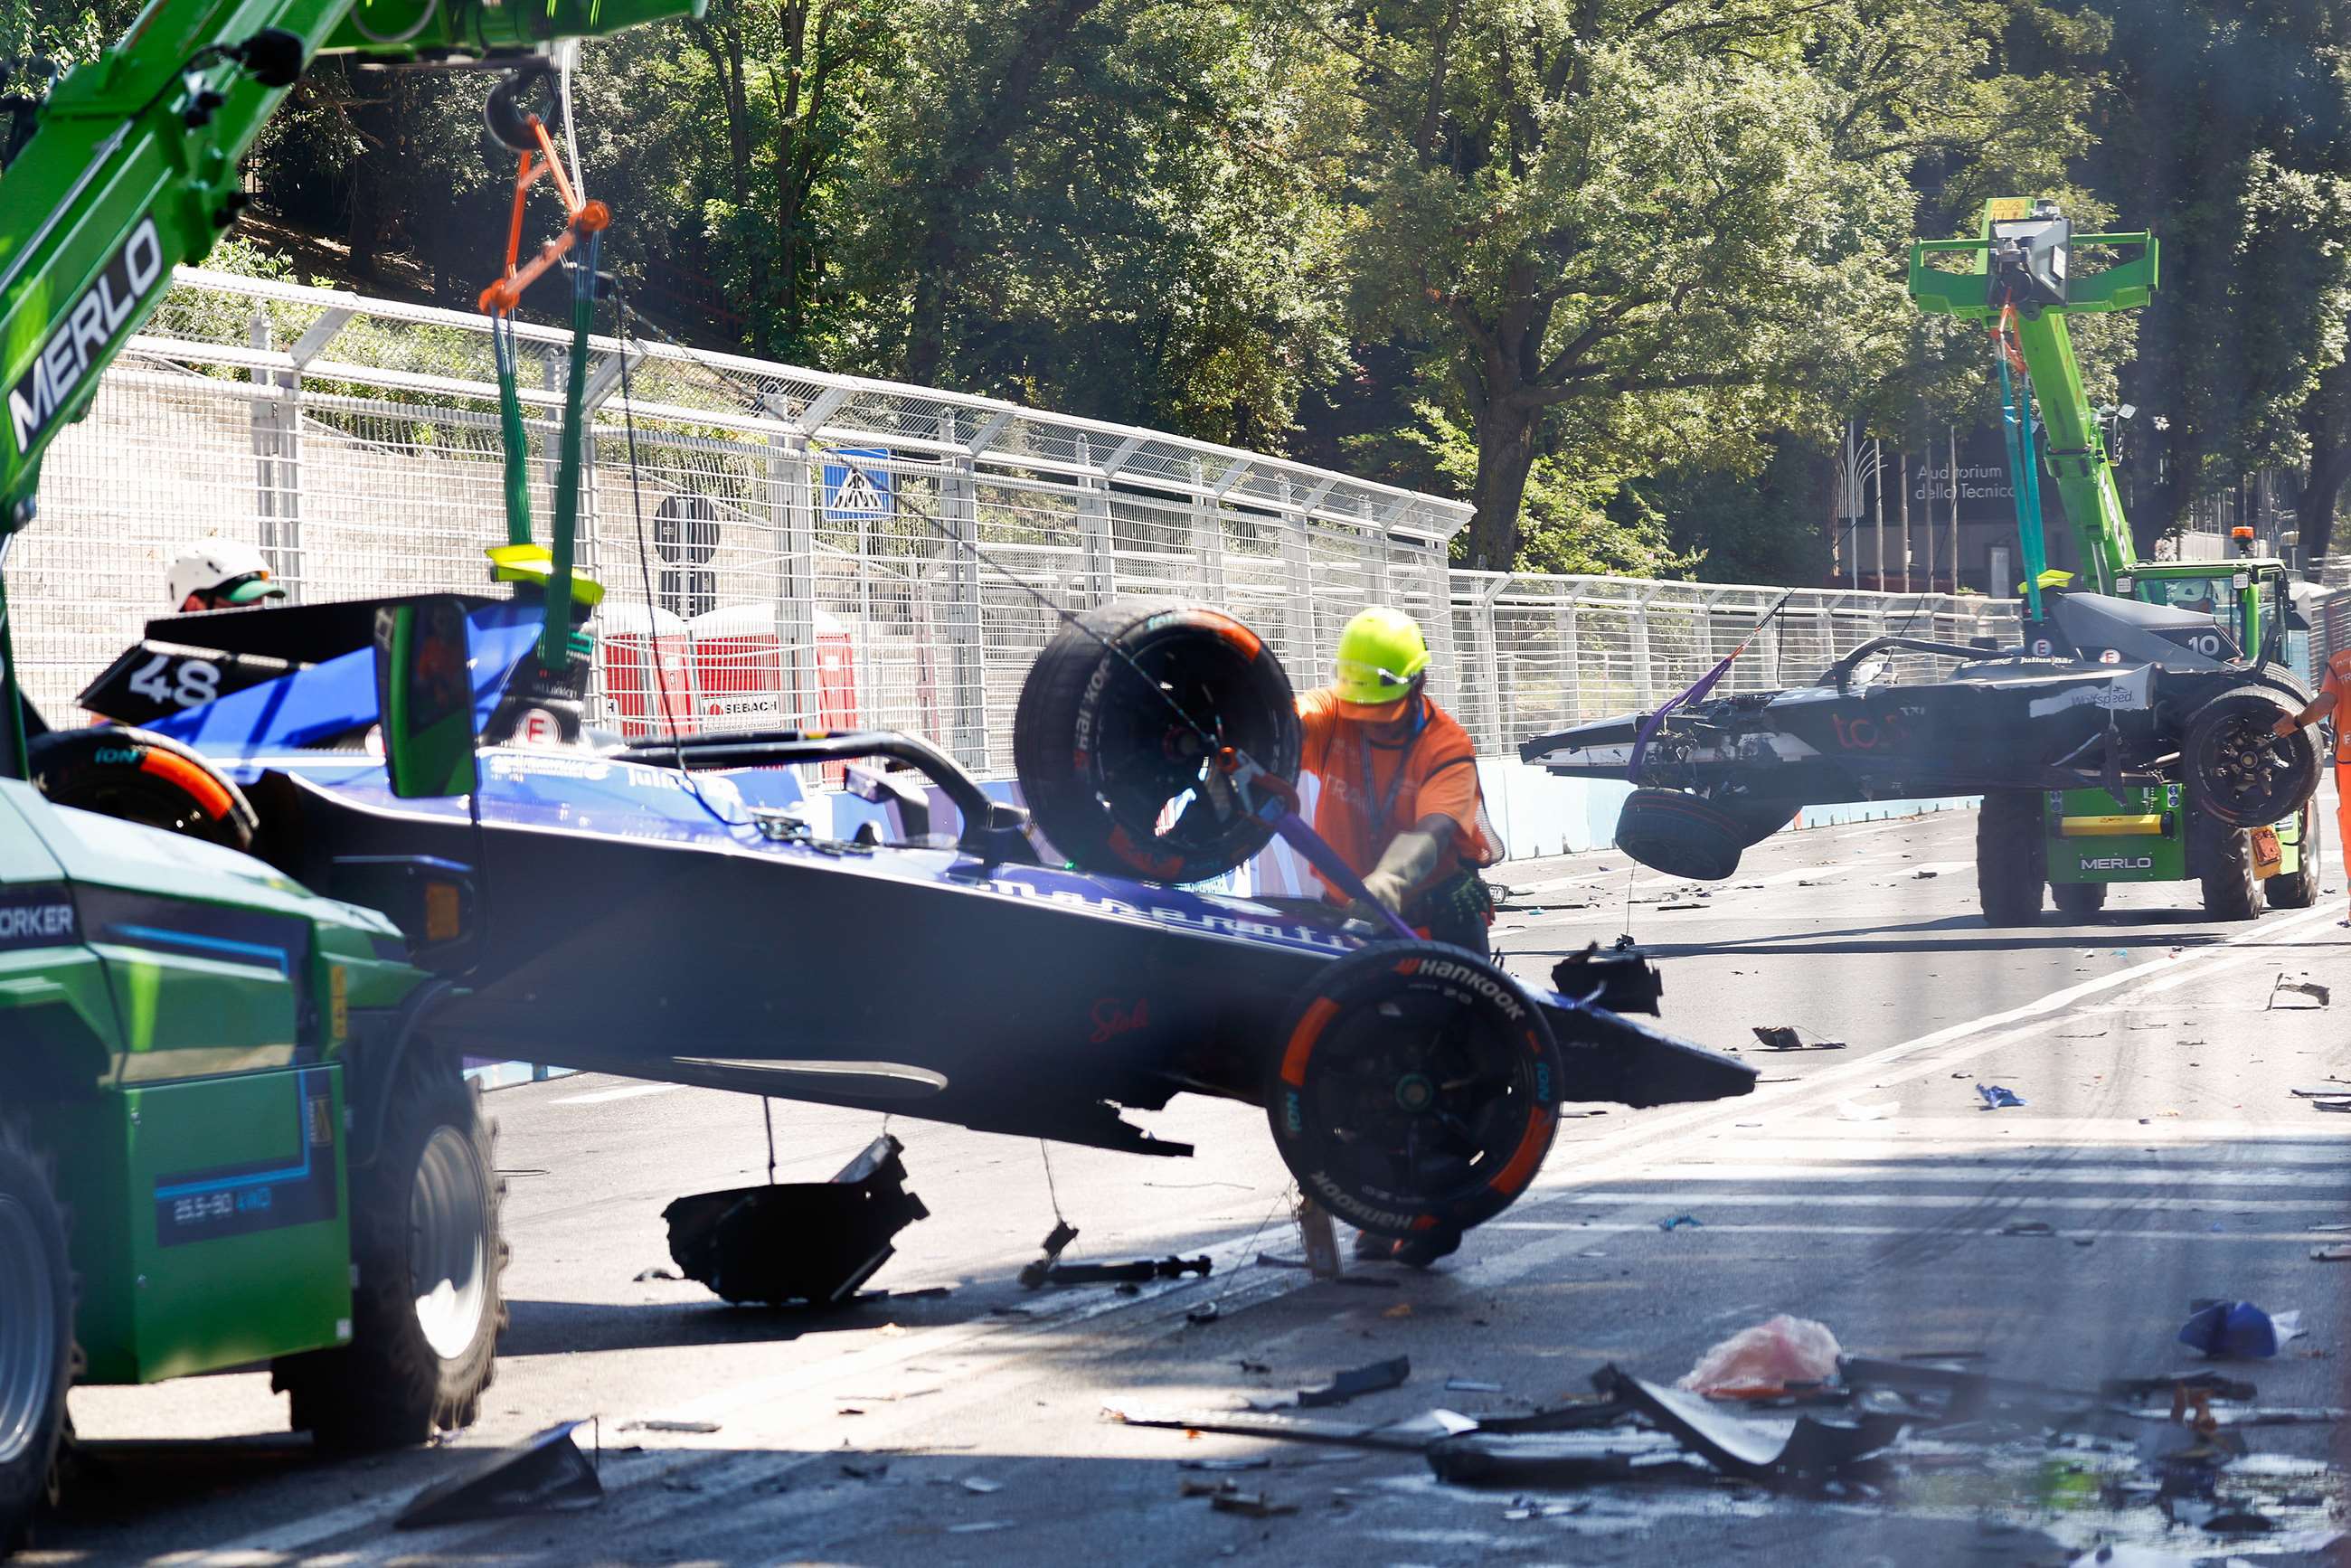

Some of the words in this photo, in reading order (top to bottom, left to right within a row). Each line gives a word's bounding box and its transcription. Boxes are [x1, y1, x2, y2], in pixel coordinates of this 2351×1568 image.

[8, 217, 164, 454] MERLO
[1917, 463, 2002, 479] Audtorium
[2036, 642, 2046, 655] E
[2188, 635, 2220, 656] 10
[129, 655, 221, 707] 48
[2081, 856, 2152, 870] MERLO
